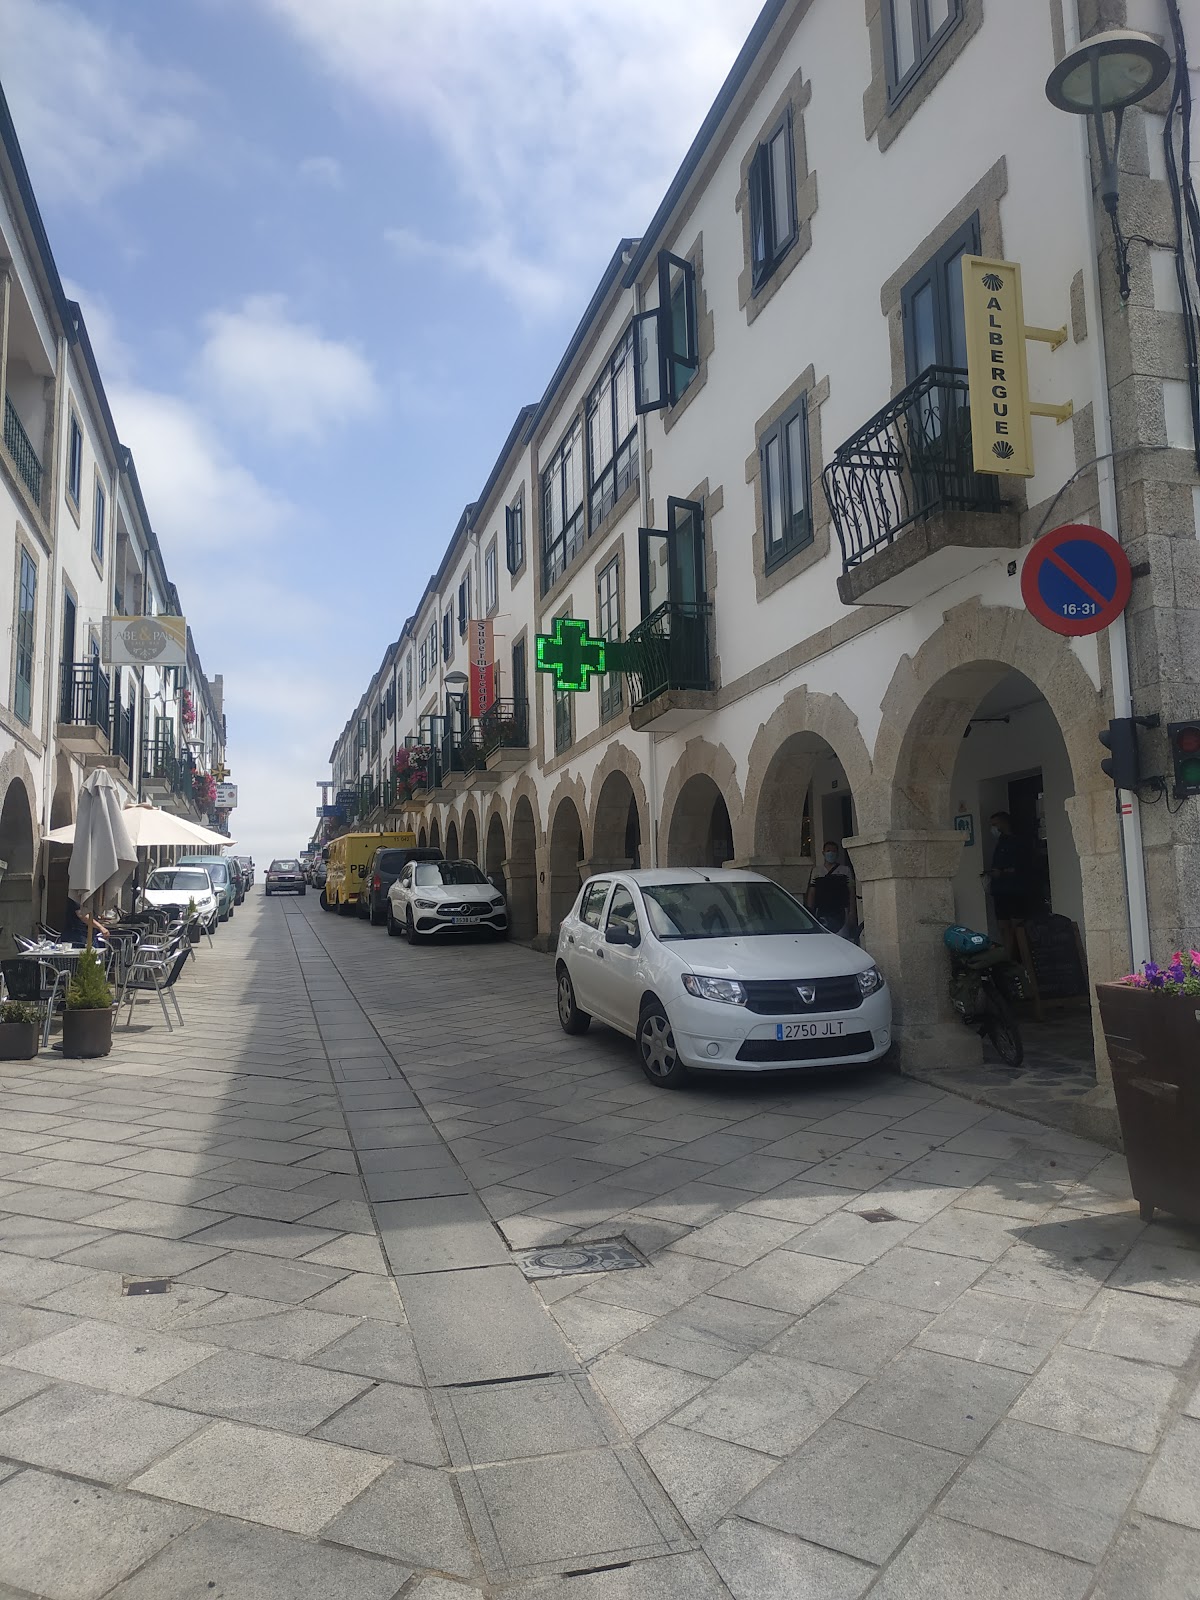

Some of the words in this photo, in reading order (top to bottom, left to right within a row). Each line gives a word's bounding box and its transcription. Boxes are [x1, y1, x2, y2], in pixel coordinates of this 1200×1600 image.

[986, 297, 1009, 435] ALBERGUE
[1062, 603, 1096, 615] 16-31
[114, 631, 137, 641] ABE
[476, 622, 488, 717] Supermercados
[785, 1024, 817, 1039] 2750
[822, 1021, 844, 1036] JLT
